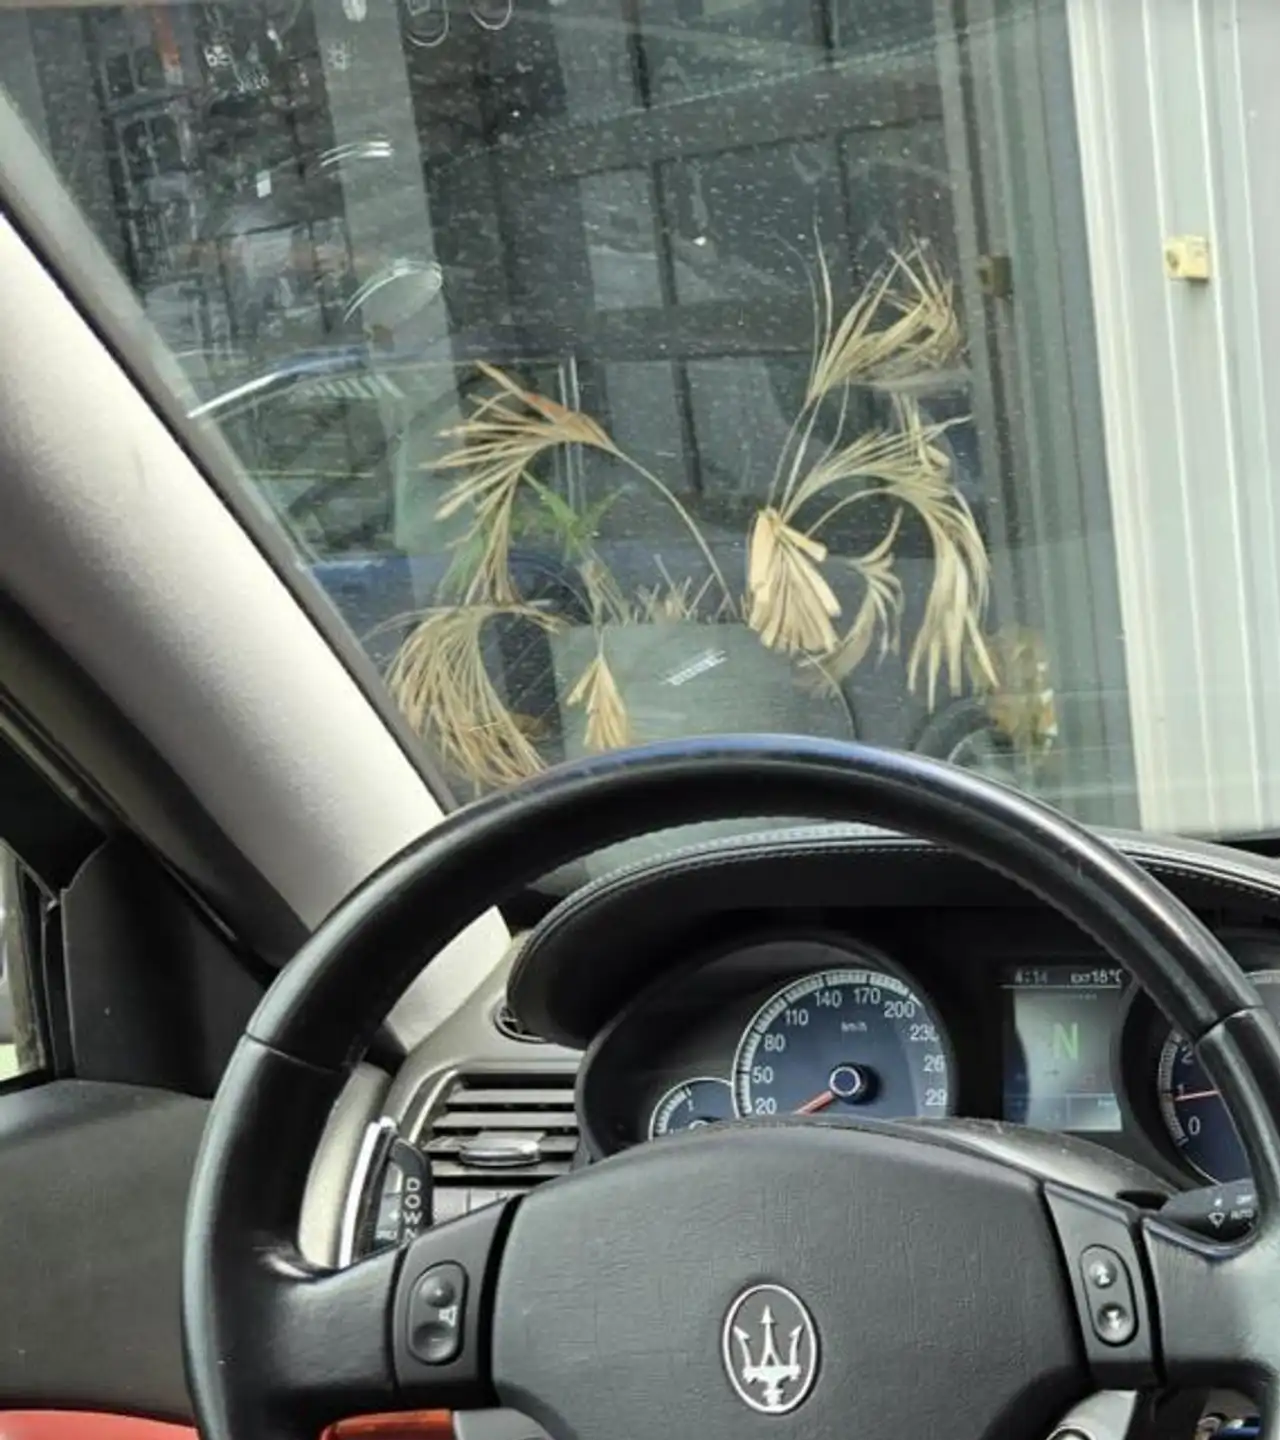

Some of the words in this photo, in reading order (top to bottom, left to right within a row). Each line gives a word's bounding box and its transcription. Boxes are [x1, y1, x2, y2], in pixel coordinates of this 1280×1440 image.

[814, 990, 842, 1008] 140
[853, 987, 881, 1004] 170
[785, 1009, 810, 1026] 110
[884, 1001, 916, 1018] 200
[764, 1034, 786, 1052] 80
[1053, 1022, 1078, 1060] N
[753, 1066, 774, 1084] 50
[755, 1097, 778, 1115] 20
[1188, 1115, 1201, 1136] 0
[404, 1177, 423, 1242] DOWN
